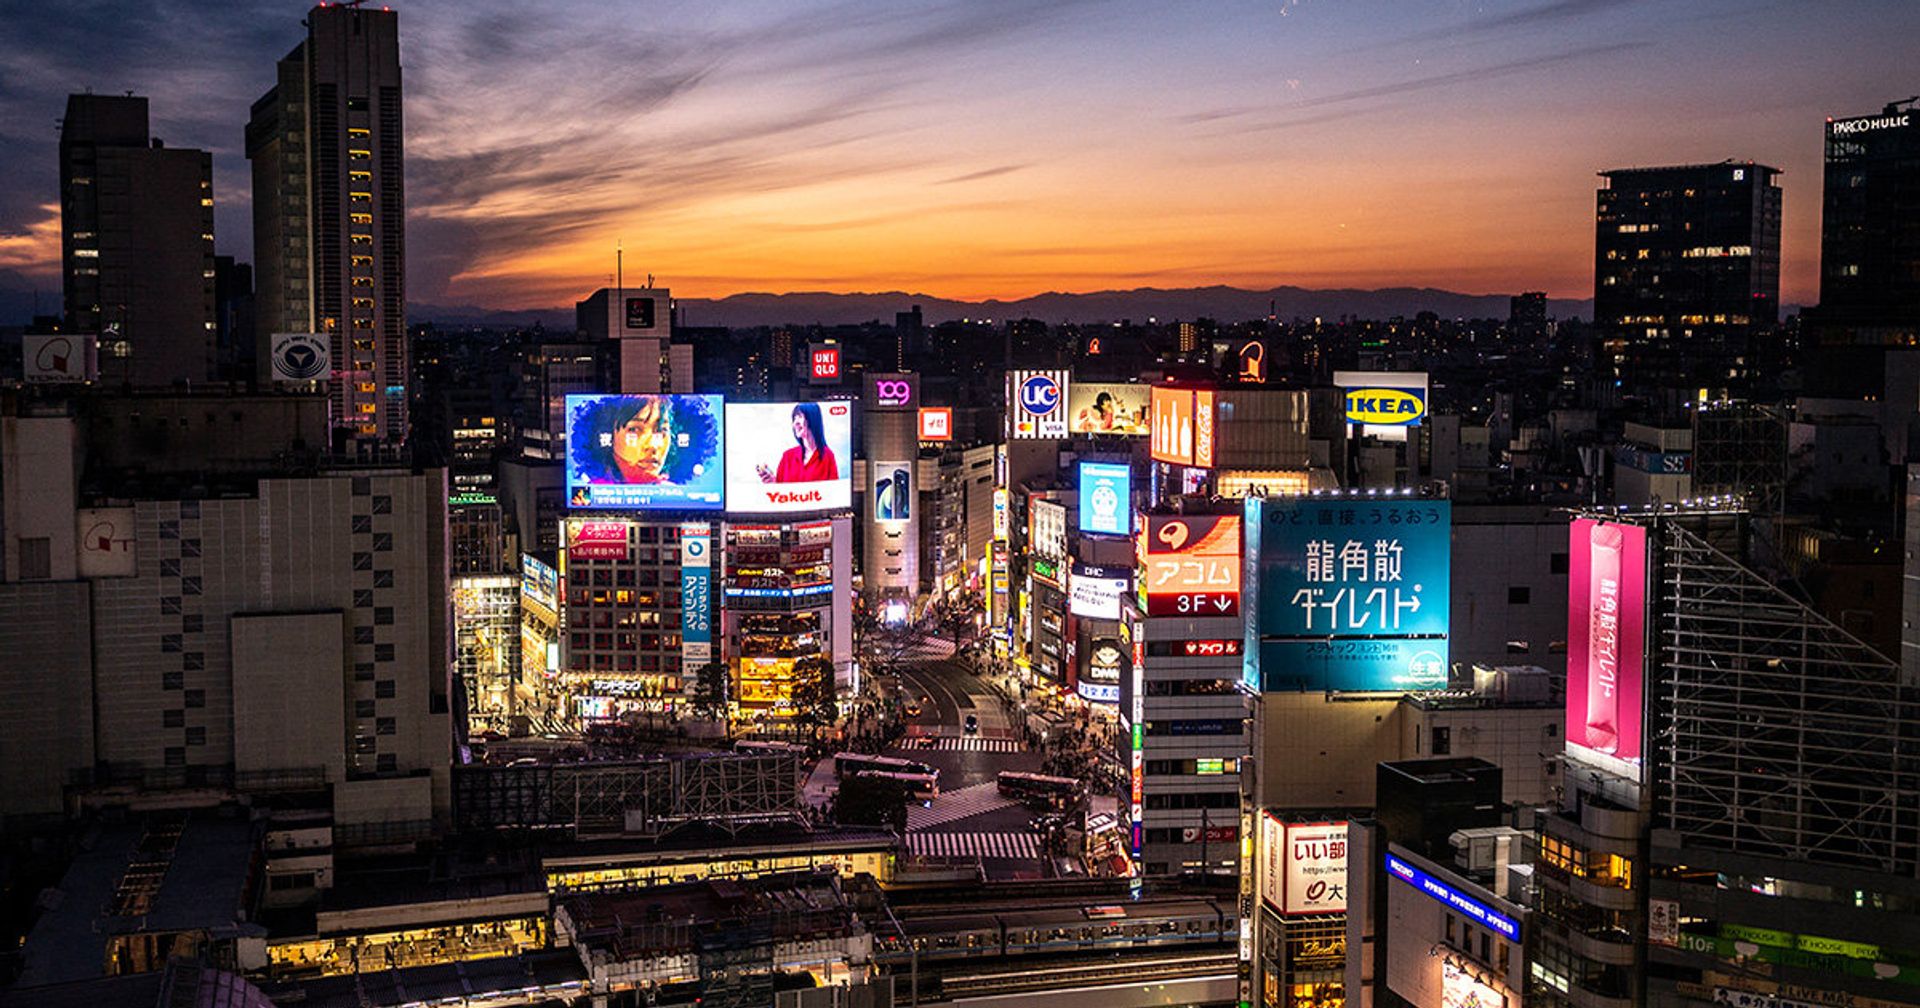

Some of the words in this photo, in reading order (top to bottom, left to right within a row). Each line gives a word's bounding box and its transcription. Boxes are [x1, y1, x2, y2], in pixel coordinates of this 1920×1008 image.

[1833, 119, 1869, 134] PARCO
[1871, 115, 1909, 130] HULIC
[815, 353, 834, 363] UNI
[815, 364, 836, 375] QLO
[877, 381, 910, 406] 109
[1023, 385, 1059, 406] UC
[1346, 398, 1418, 414] IKEA
[766, 490, 823, 504] Yakult
[1306, 539, 1404, 582] 龍角散
[763, 567, 785, 577] ガスト
[1155, 561, 1232, 586] アコム
[684, 575, 698, 631] アイシティ
[1177, 595, 1207, 613] 3F
[1291, 588, 1421, 629] ダイレクト
[1294, 841, 1346, 861] いい部
